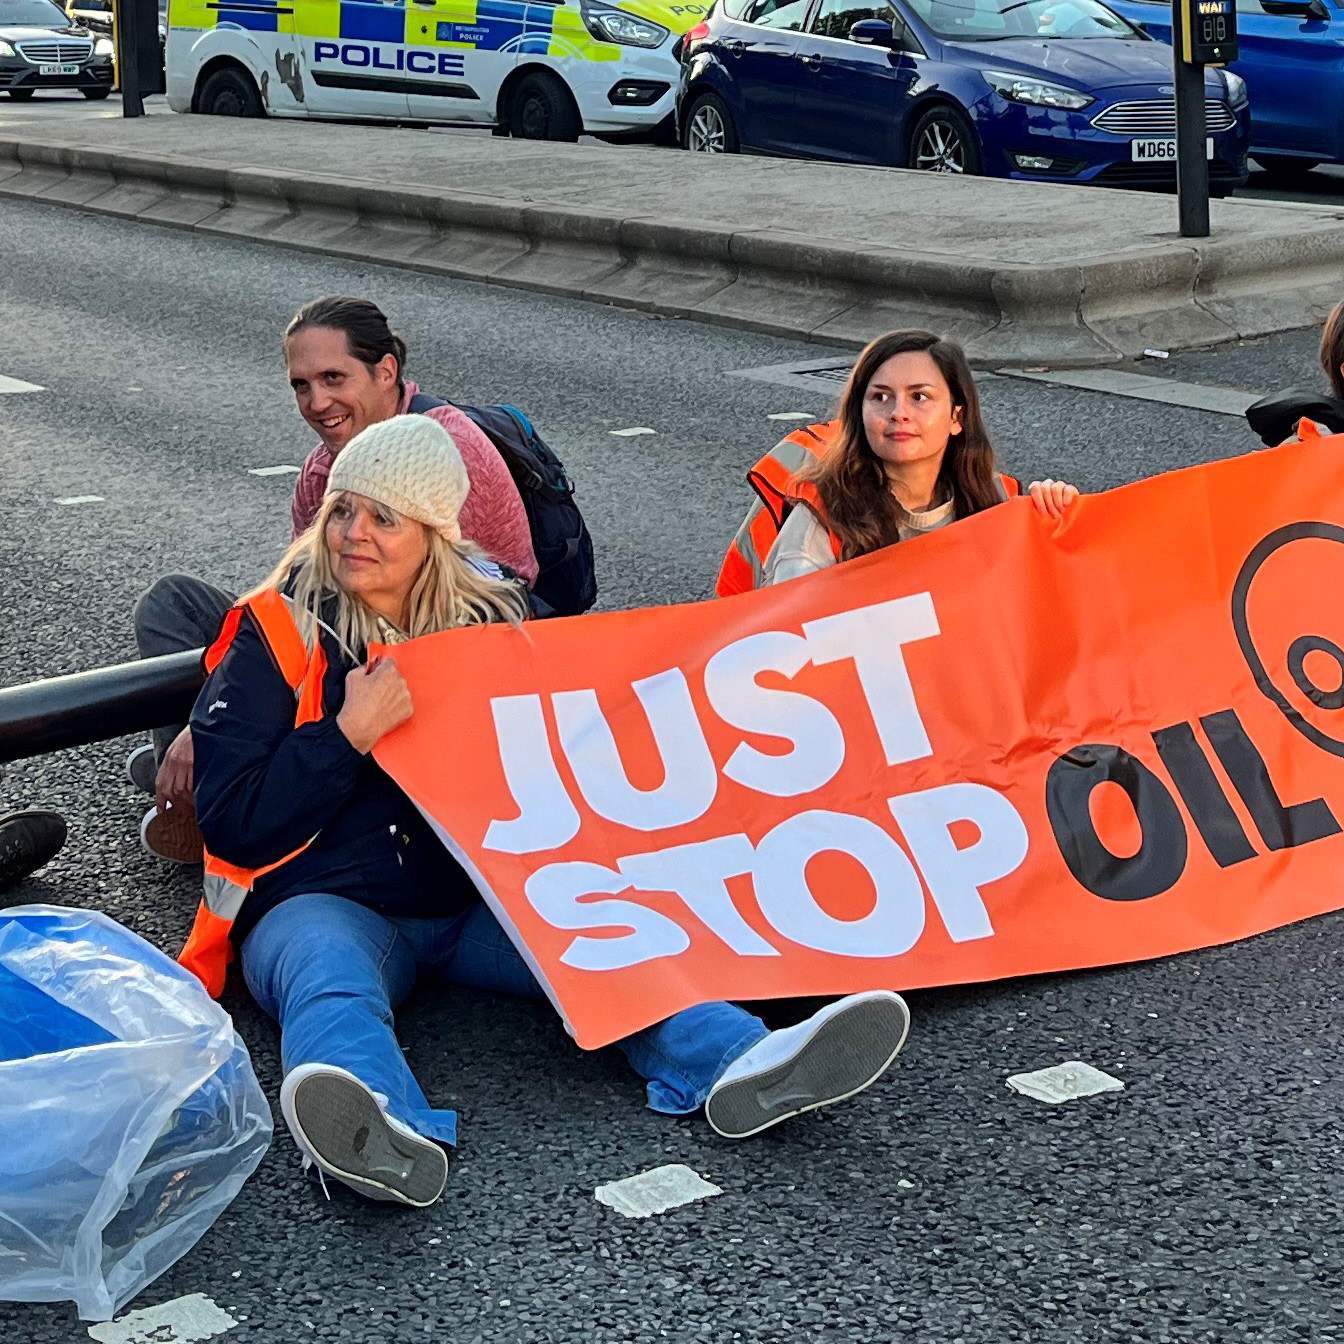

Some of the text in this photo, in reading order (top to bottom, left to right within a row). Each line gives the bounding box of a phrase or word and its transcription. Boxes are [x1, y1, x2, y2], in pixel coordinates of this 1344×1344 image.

[459, 33, 485, 41] POLICE
[314, 42, 465, 76] POLICE
[1137, 141, 1176, 158] WD66
[482, 592, 941, 855] JUST
[525, 708, 1343, 971] STOP OIL
